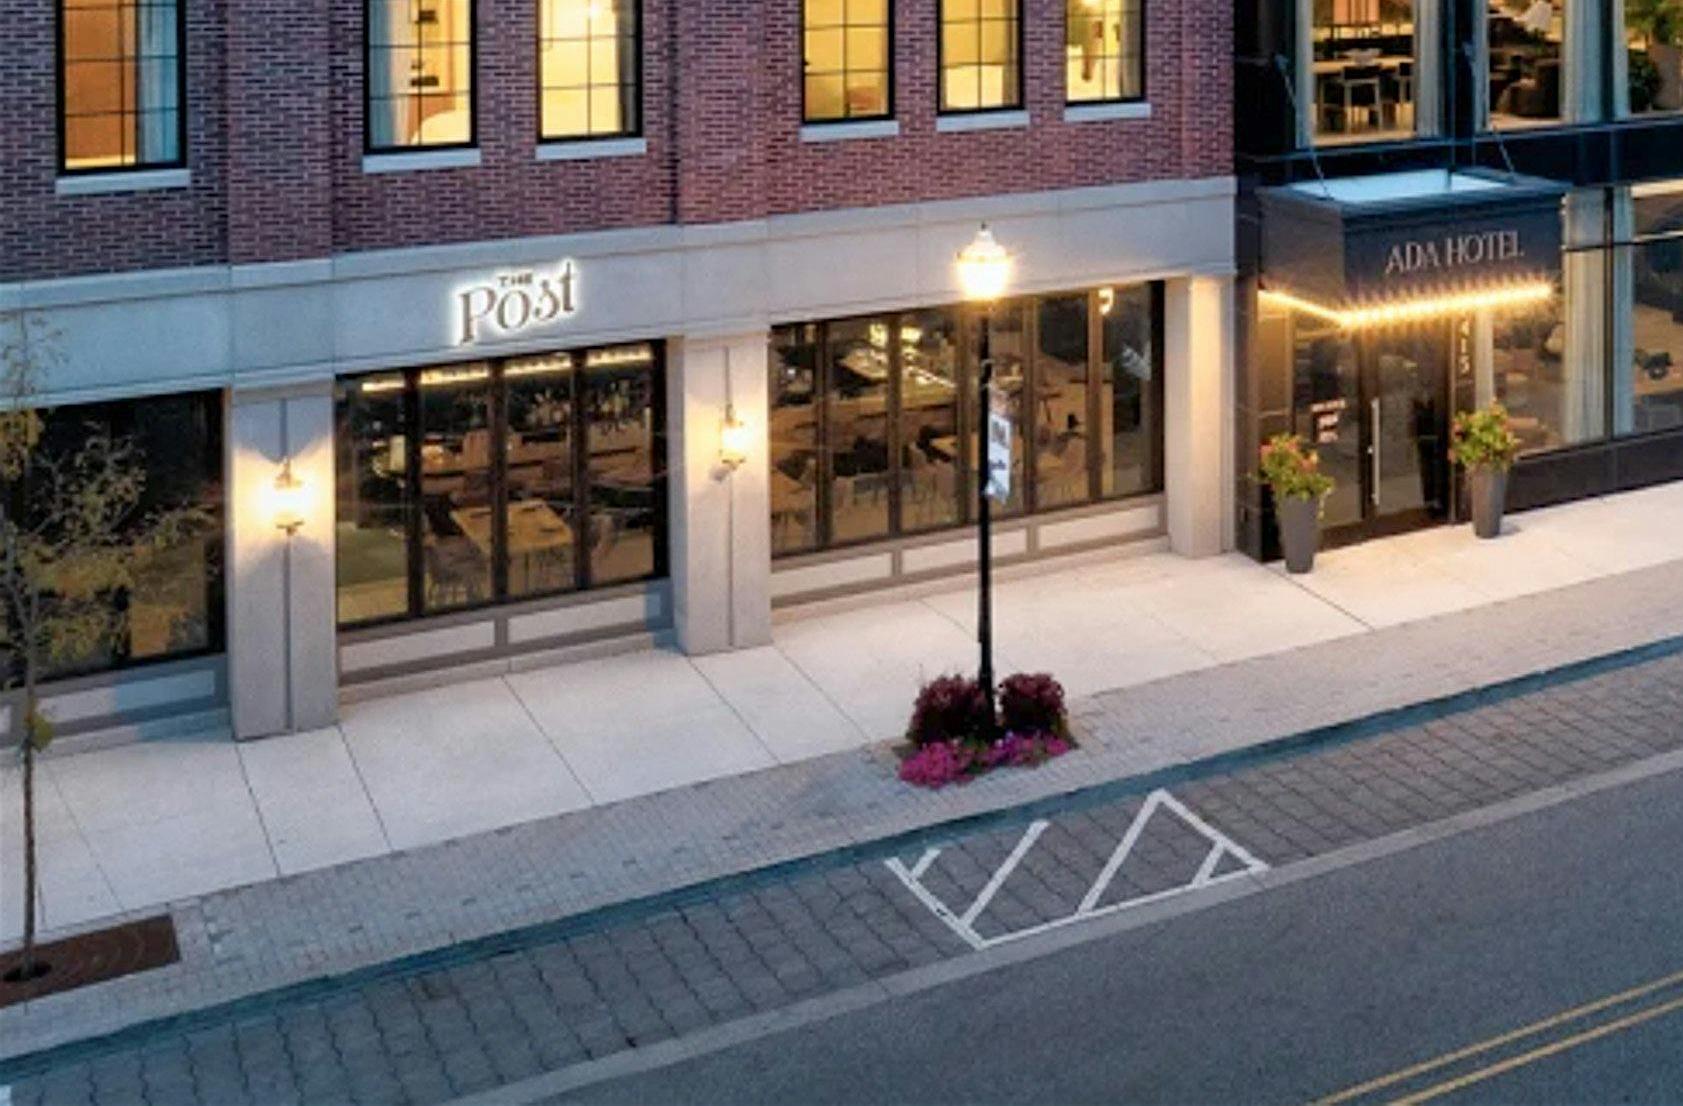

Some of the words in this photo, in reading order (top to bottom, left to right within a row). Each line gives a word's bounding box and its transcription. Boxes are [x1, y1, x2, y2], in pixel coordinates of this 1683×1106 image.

[1384, 240, 1441, 274] ADA
[1446, 230, 1525, 267] HOTEL
[497, 272, 533, 288] THE
